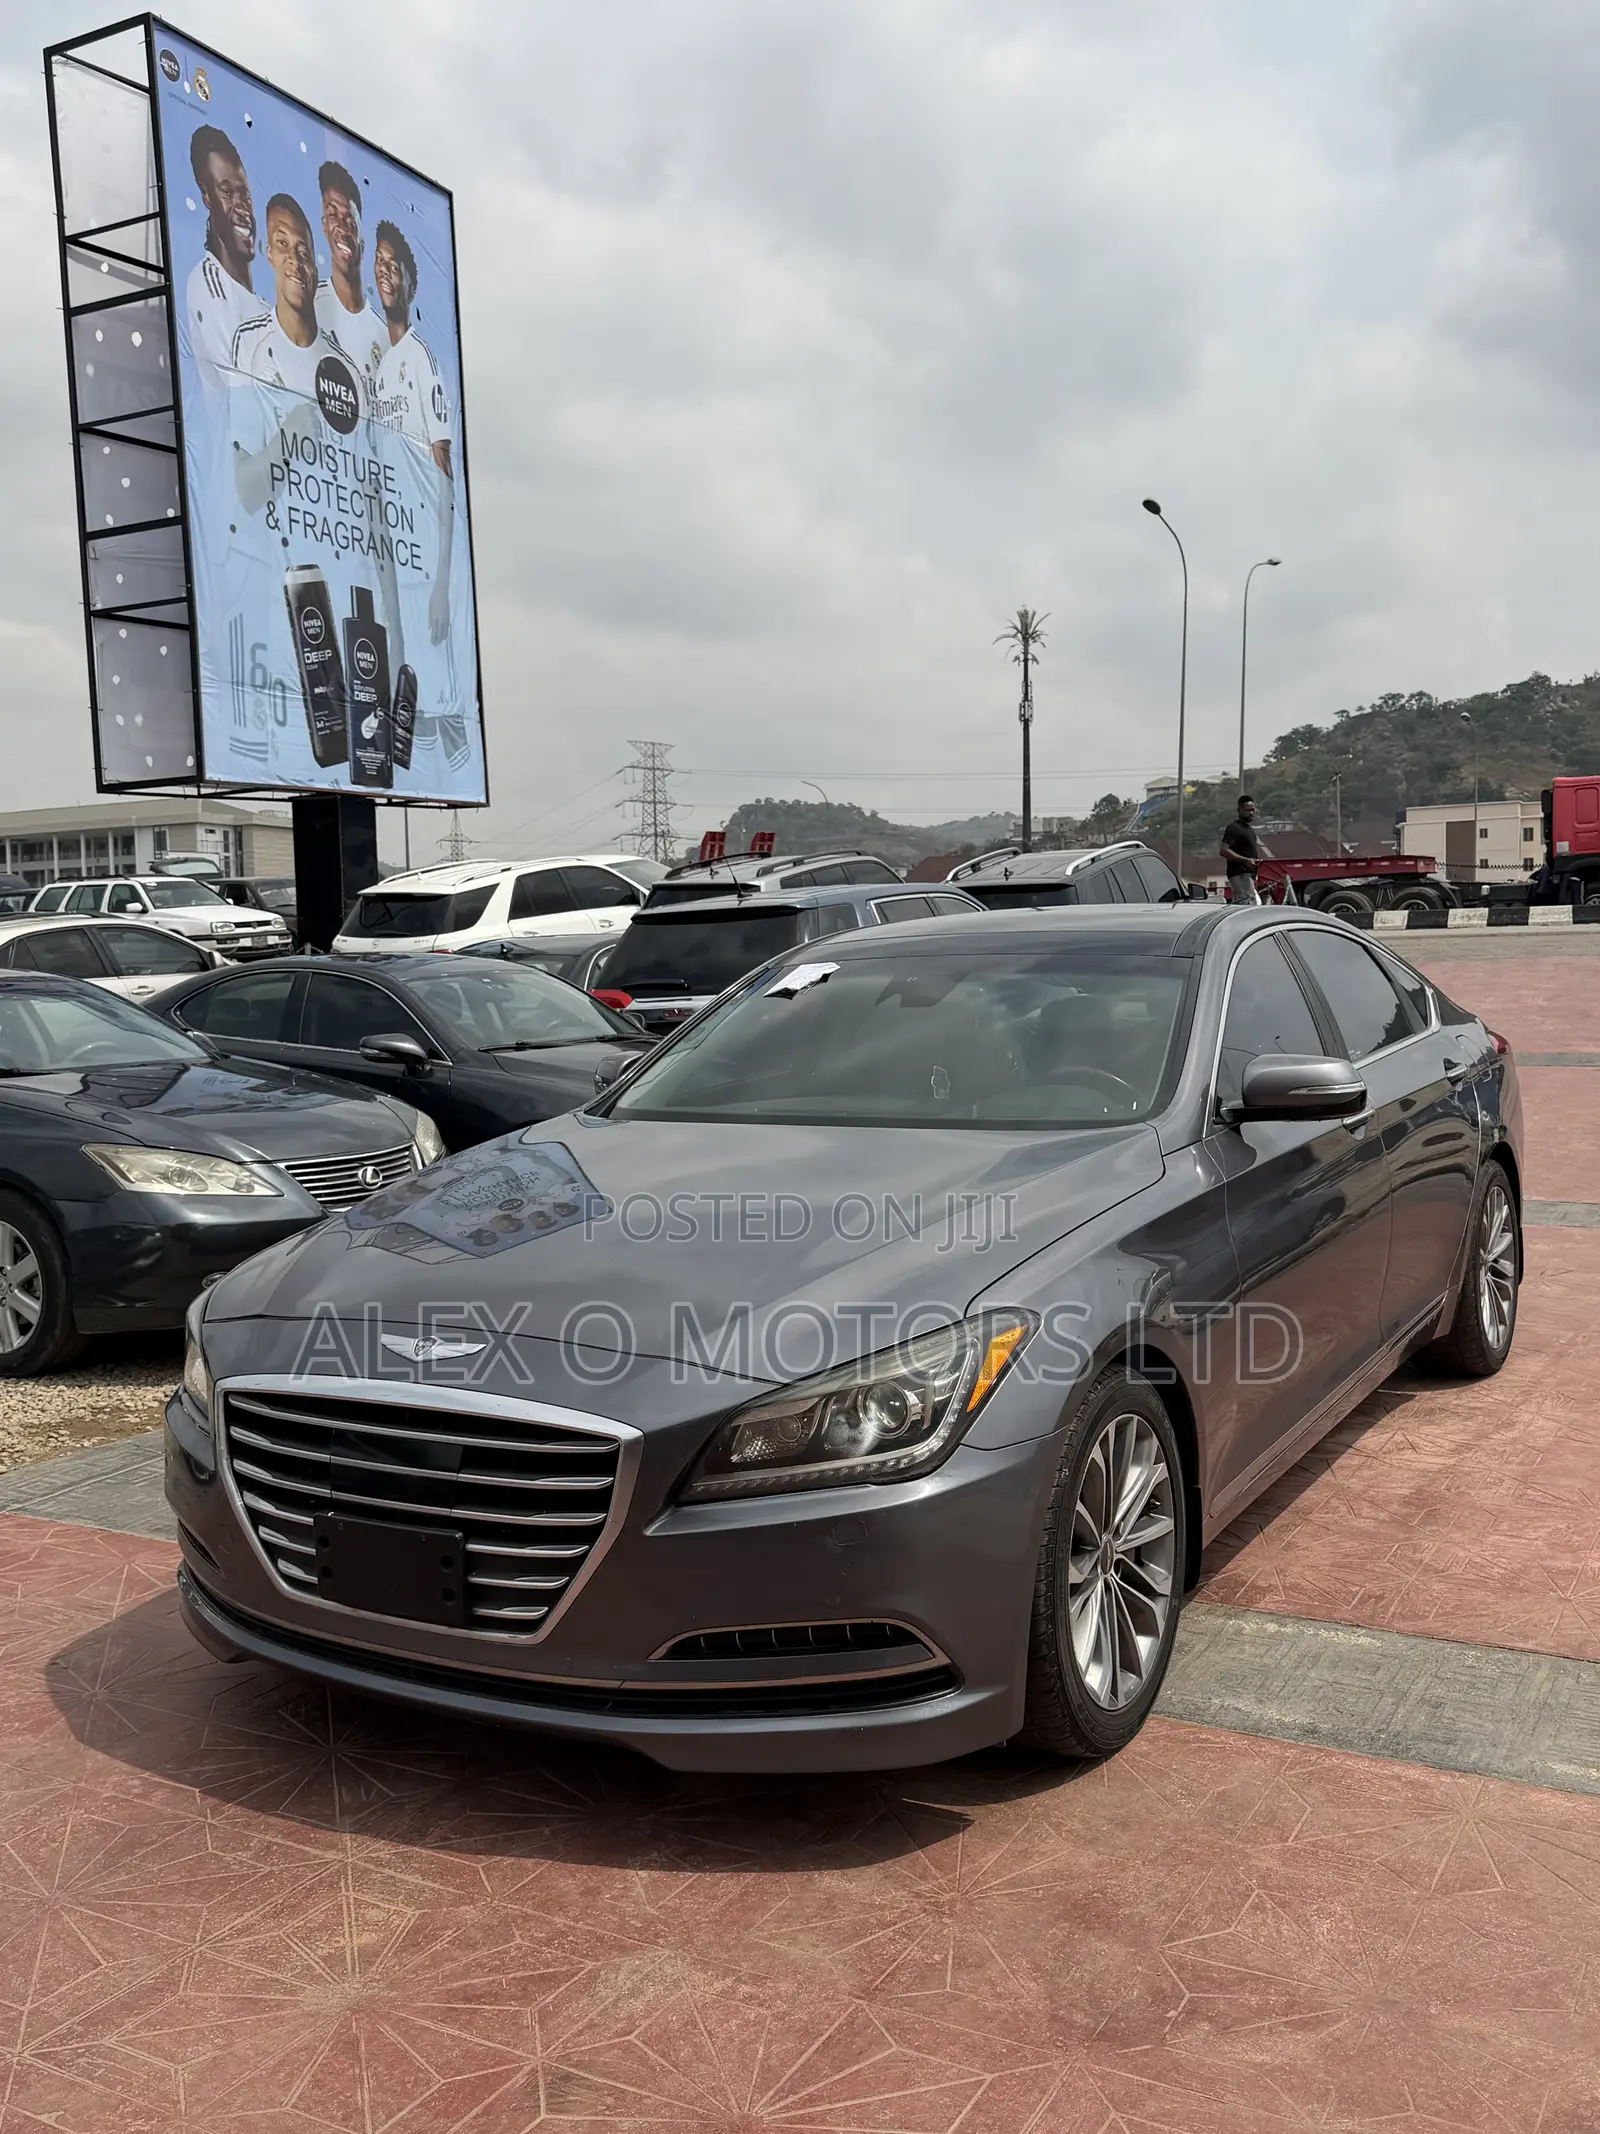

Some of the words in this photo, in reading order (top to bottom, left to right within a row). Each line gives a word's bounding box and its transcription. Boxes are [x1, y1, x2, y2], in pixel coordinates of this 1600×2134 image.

[319, 376, 356, 405] NIVEA
[325, 396, 352, 419] MEN
[280, 427, 402, 500] MOISTURE,
[270, 462, 414, 534] PROTECTION
[266, 500, 281, 532] &
[288, 505, 423, 571] FRAGRANCE
[303, 619, 322, 629] NIVEA
[306, 627, 321, 635] MEN
[303, 649, 332, 664] DEEP
[356, 651, 375, 662] NIVEA
[359, 660, 374, 670] MEN
[354, 690, 378, 703] DEEP
